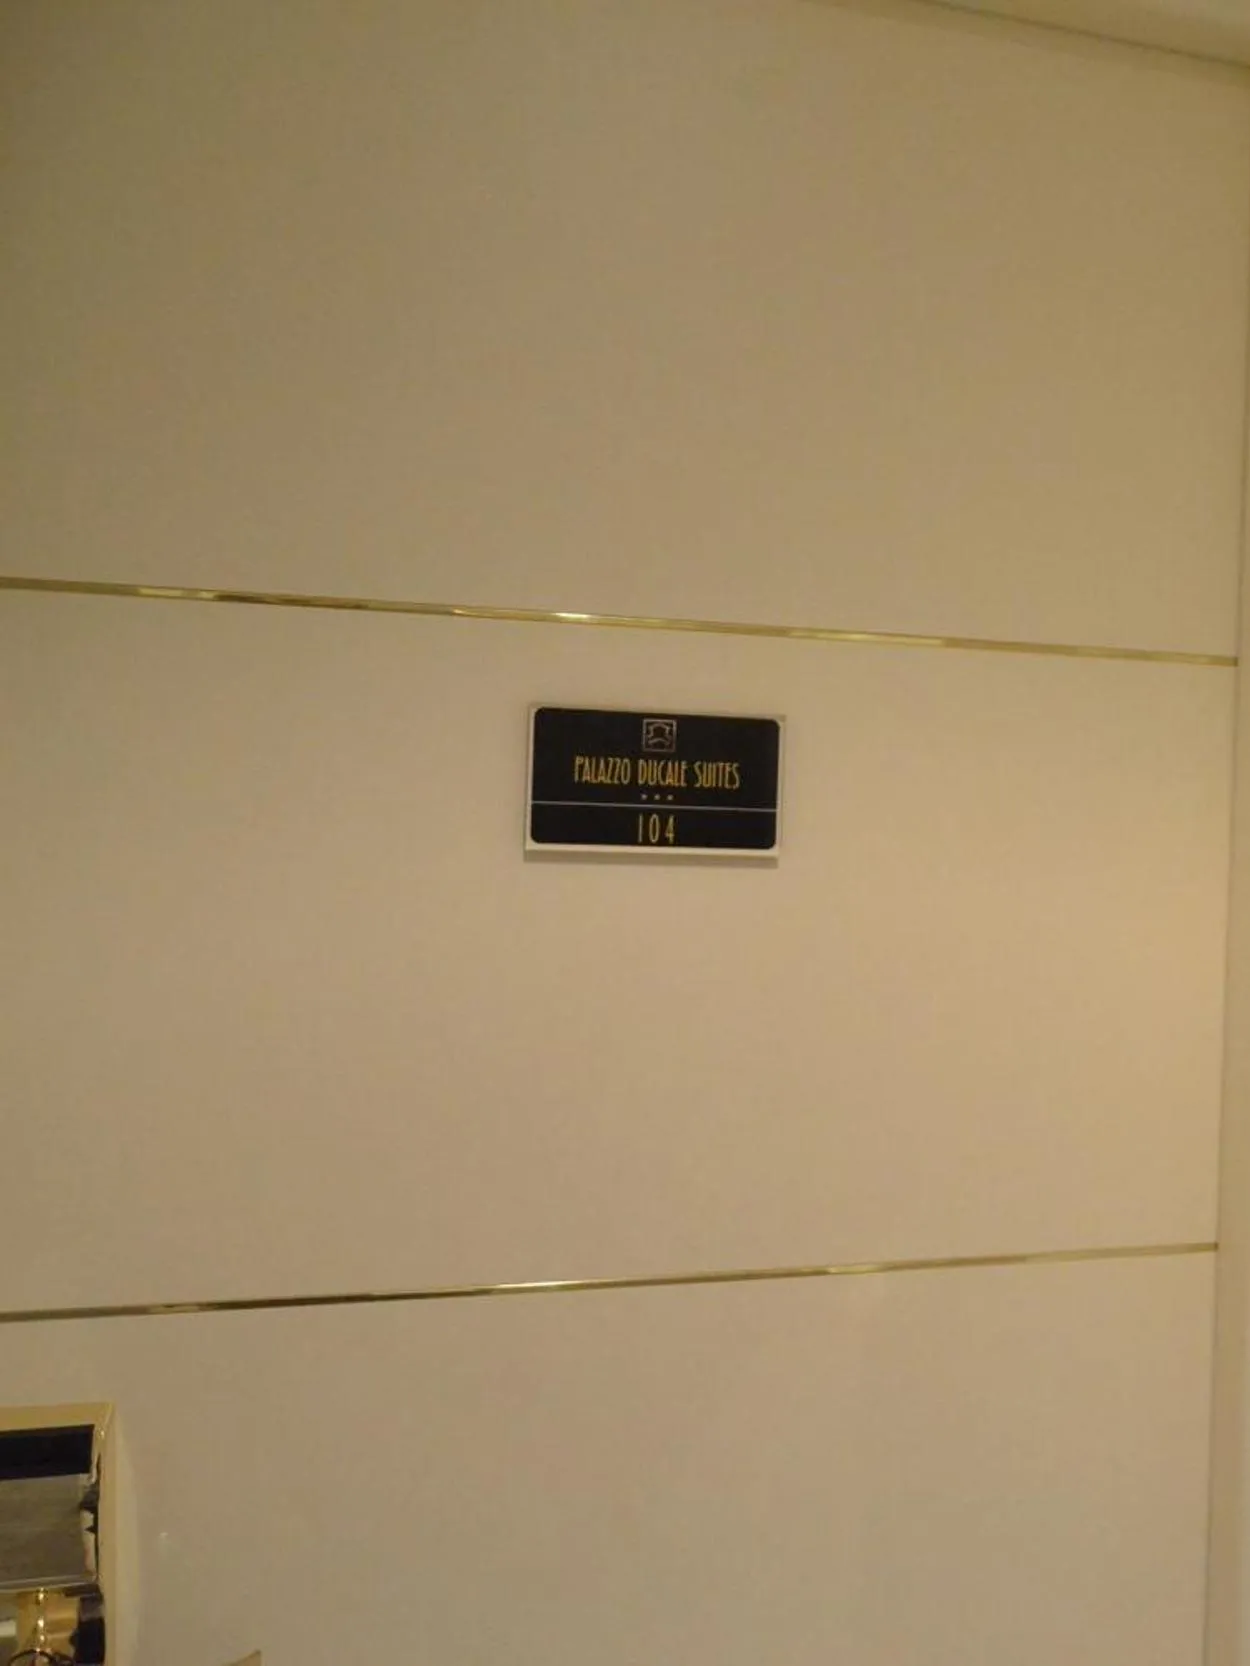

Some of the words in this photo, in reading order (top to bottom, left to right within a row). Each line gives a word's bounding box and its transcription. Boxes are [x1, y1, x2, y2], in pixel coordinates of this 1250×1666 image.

[574, 755, 631, 785] PALAZZO
[638, 758, 688, 787] DUCALE
[694, 762, 741, 789] SUITES
[637, 813, 675, 844] 104
